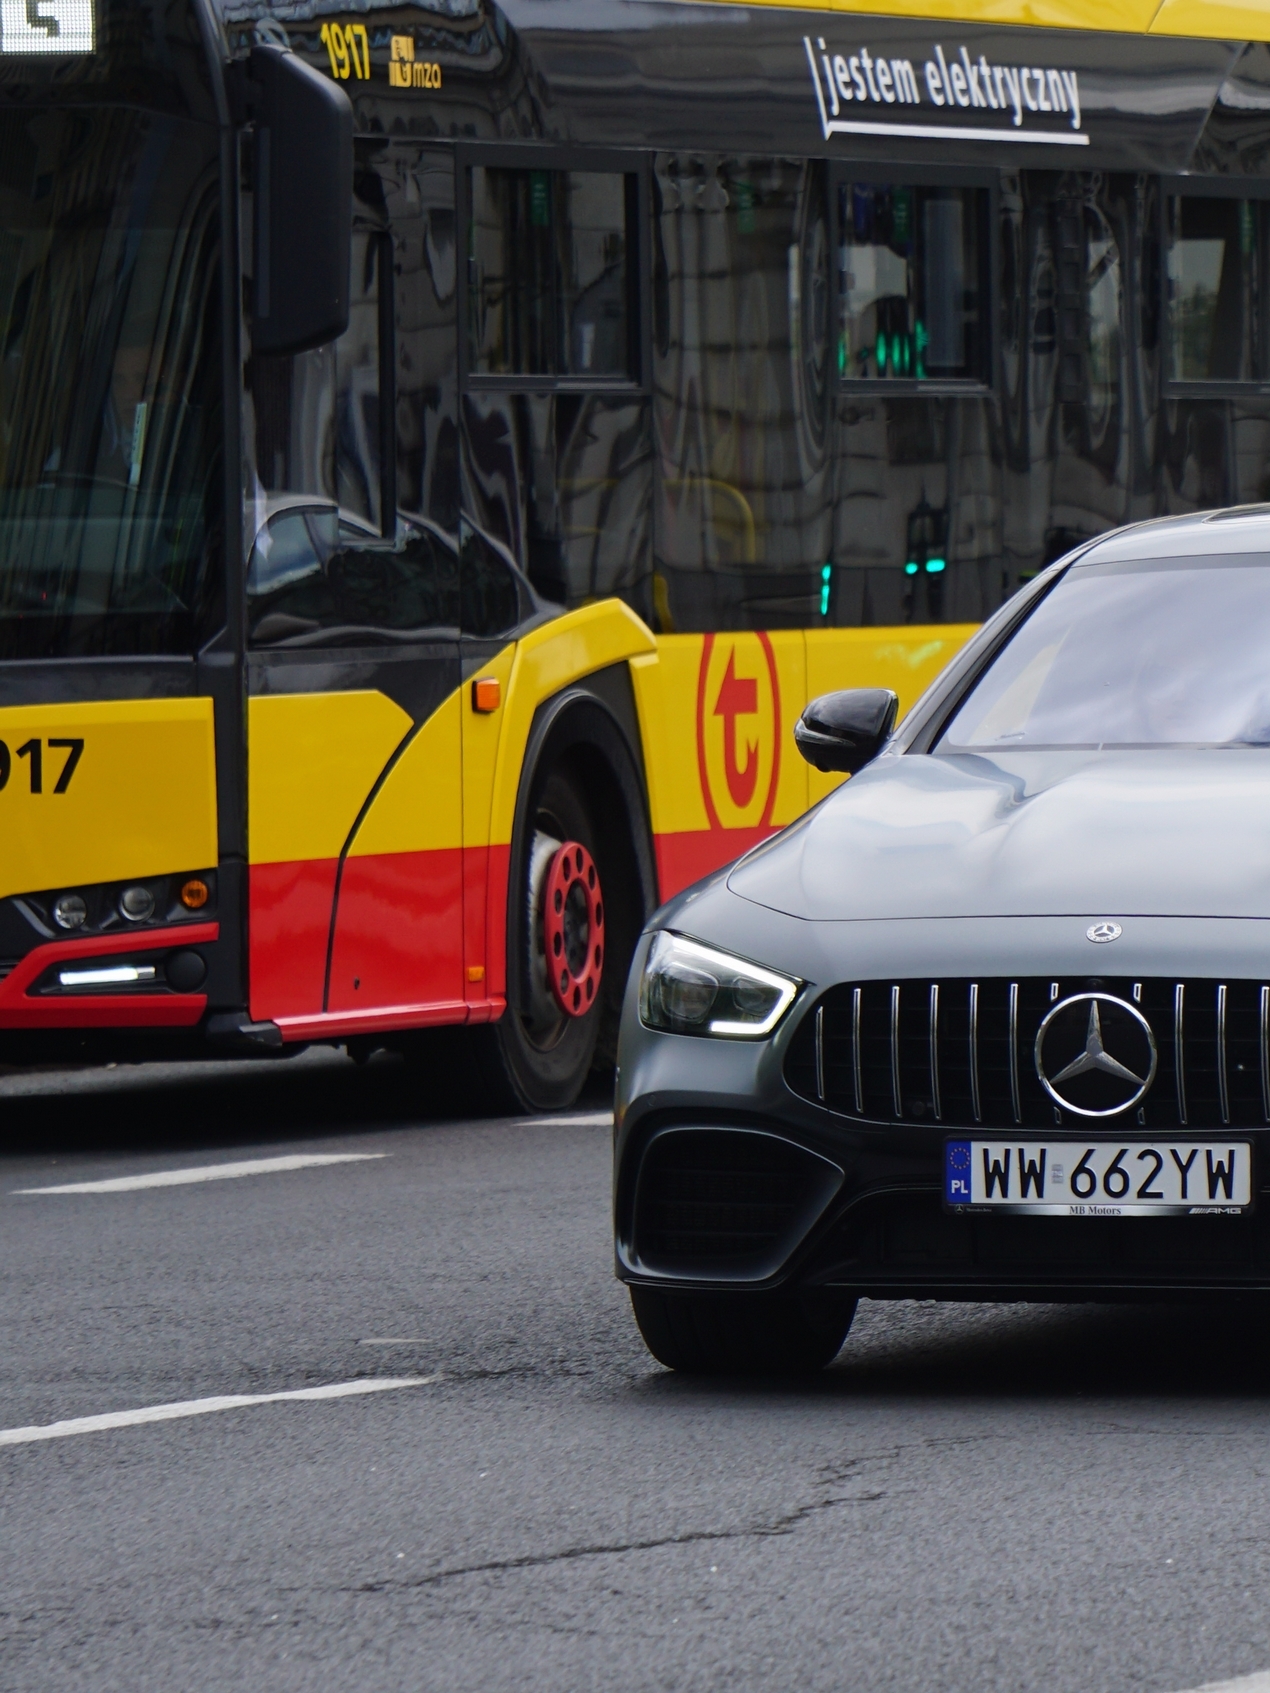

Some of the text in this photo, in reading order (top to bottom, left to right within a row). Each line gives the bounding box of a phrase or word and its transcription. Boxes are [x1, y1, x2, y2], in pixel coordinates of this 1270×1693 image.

[321, 23, 370, 80] 1917
[817, 36, 1081, 130] jestem elektryczny
[0, 738, 84, 794] 17
[951, 1179, 969, 1194] PL
[983, 1148, 1236, 1200] WW 662YW
[1069, 1206, 1122, 1215] MB Motors
